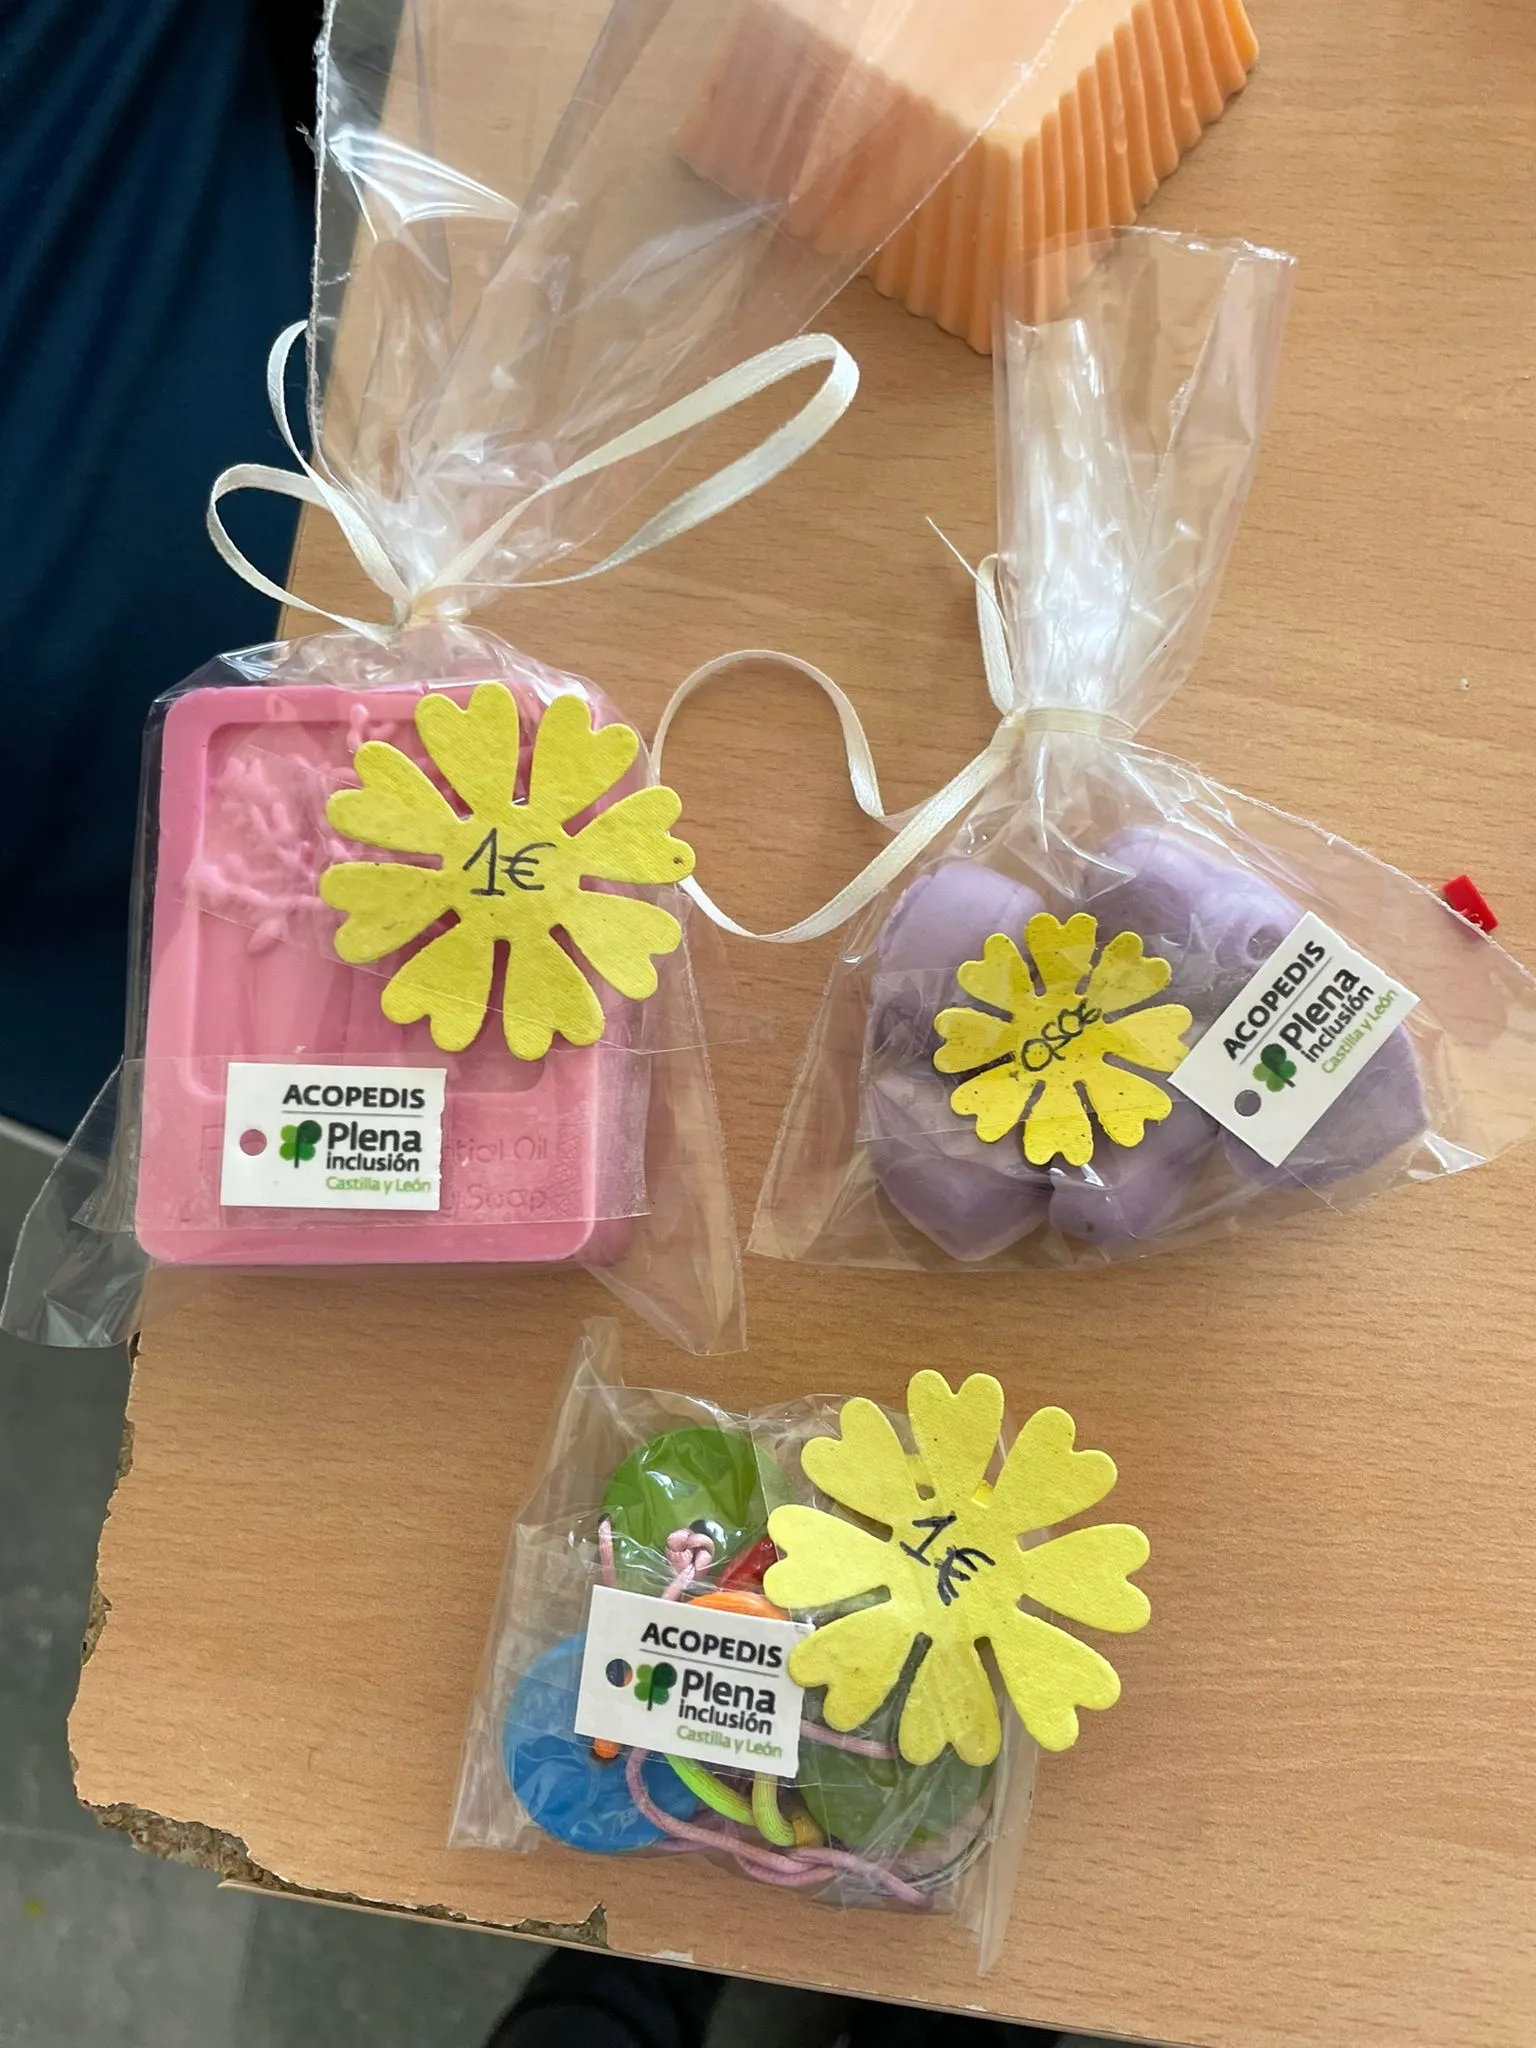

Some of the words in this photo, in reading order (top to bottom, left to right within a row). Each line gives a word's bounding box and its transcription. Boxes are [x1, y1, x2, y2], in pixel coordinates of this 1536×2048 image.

[462, 827, 558, 896] 1€
[1222, 940, 1326, 1061] ACOPEDIS
[1279, 968, 1360, 1050] Plena
[1301, 984, 1375, 1063] inclusión
[1321, 1027, 1363, 1074] Castilla
[1371, 988, 1399, 1022] León
[282, 1083, 426, 1109] ACOPEDIS
[327, 1121, 422, 1153] Plena
[326, 1151, 420, 1173] inclusión
[326, 1176, 382, 1192] Castilla
[384, 1181, 393, 1195] y
[395, 1177, 432, 1194] León
[899, 1510, 997, 1607] 1€
[640, 1622, 783, 1669] ACOPEDIS
[681, 1668, 776, 1716] Plena
[678, 1699, 773, 1736] inclusión
[676, 1724, 731, 1750] Castilla
[731, 1739, 743, 1754] y
[748, 1738, 783, 1759] León
